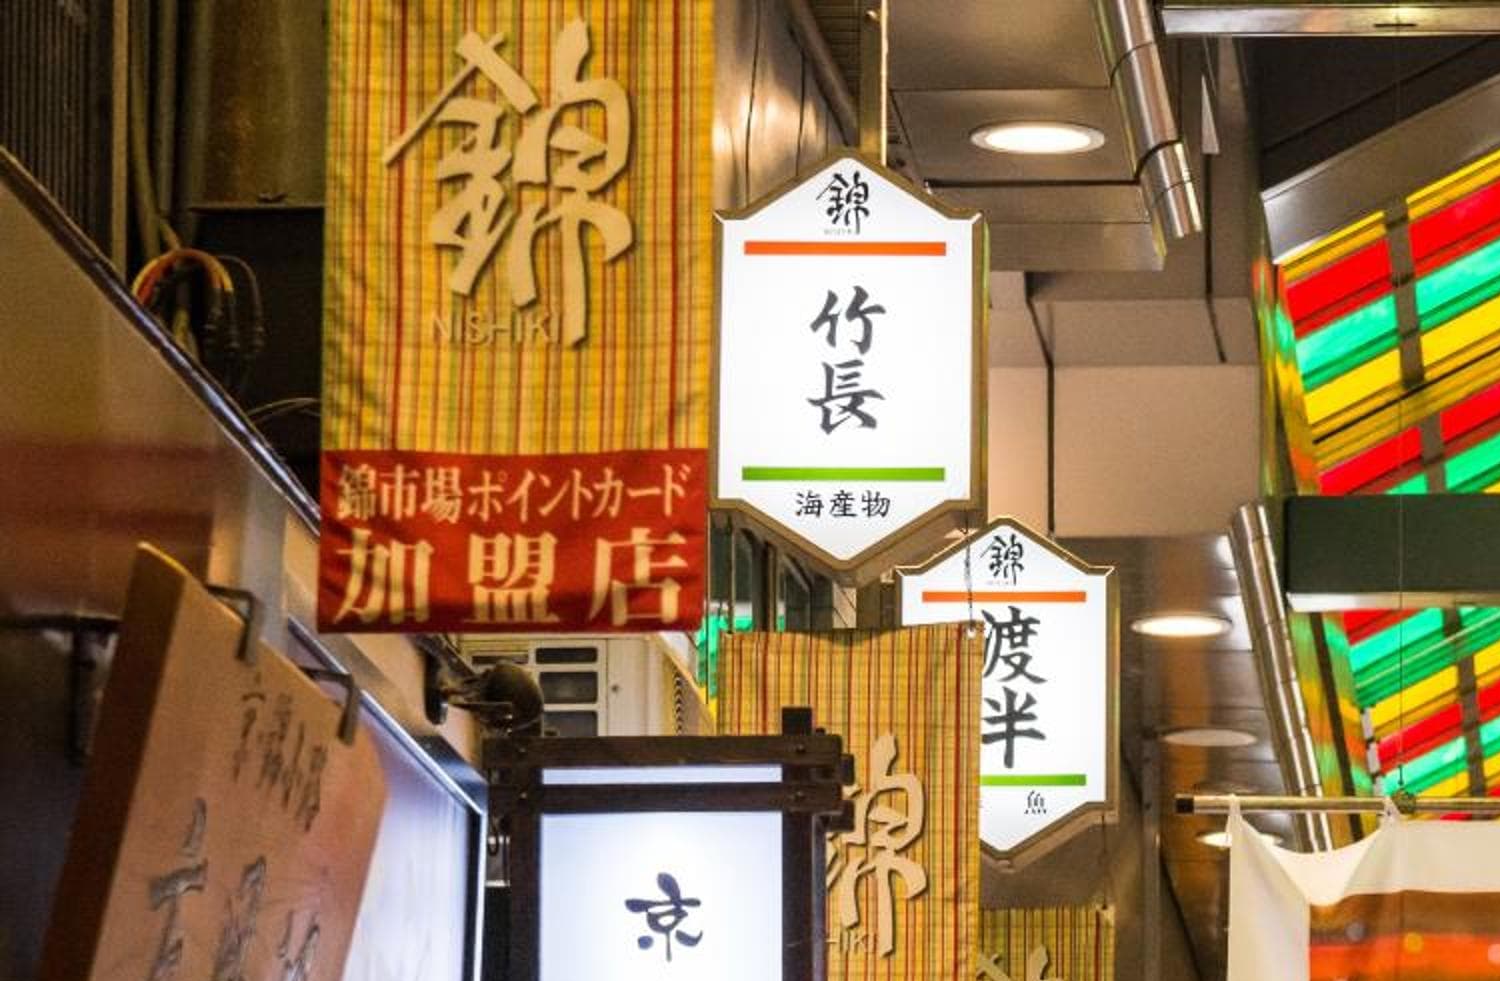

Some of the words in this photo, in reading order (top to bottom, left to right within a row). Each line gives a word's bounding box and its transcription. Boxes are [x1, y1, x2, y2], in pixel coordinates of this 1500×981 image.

[383, 16, 634, 349] 錦
[815, 170, 870, 235] 錦
[805, 284, 887, 436] 竹長
[335, 462, 692, 525] 錦市場ポイントカード
[794, 488, 892, 519] 海産物
[333, 526, 690, 628] 加盟店
[979, 533, 1025, 586] 錦
[981, 604, 1048, 770] 渡半
